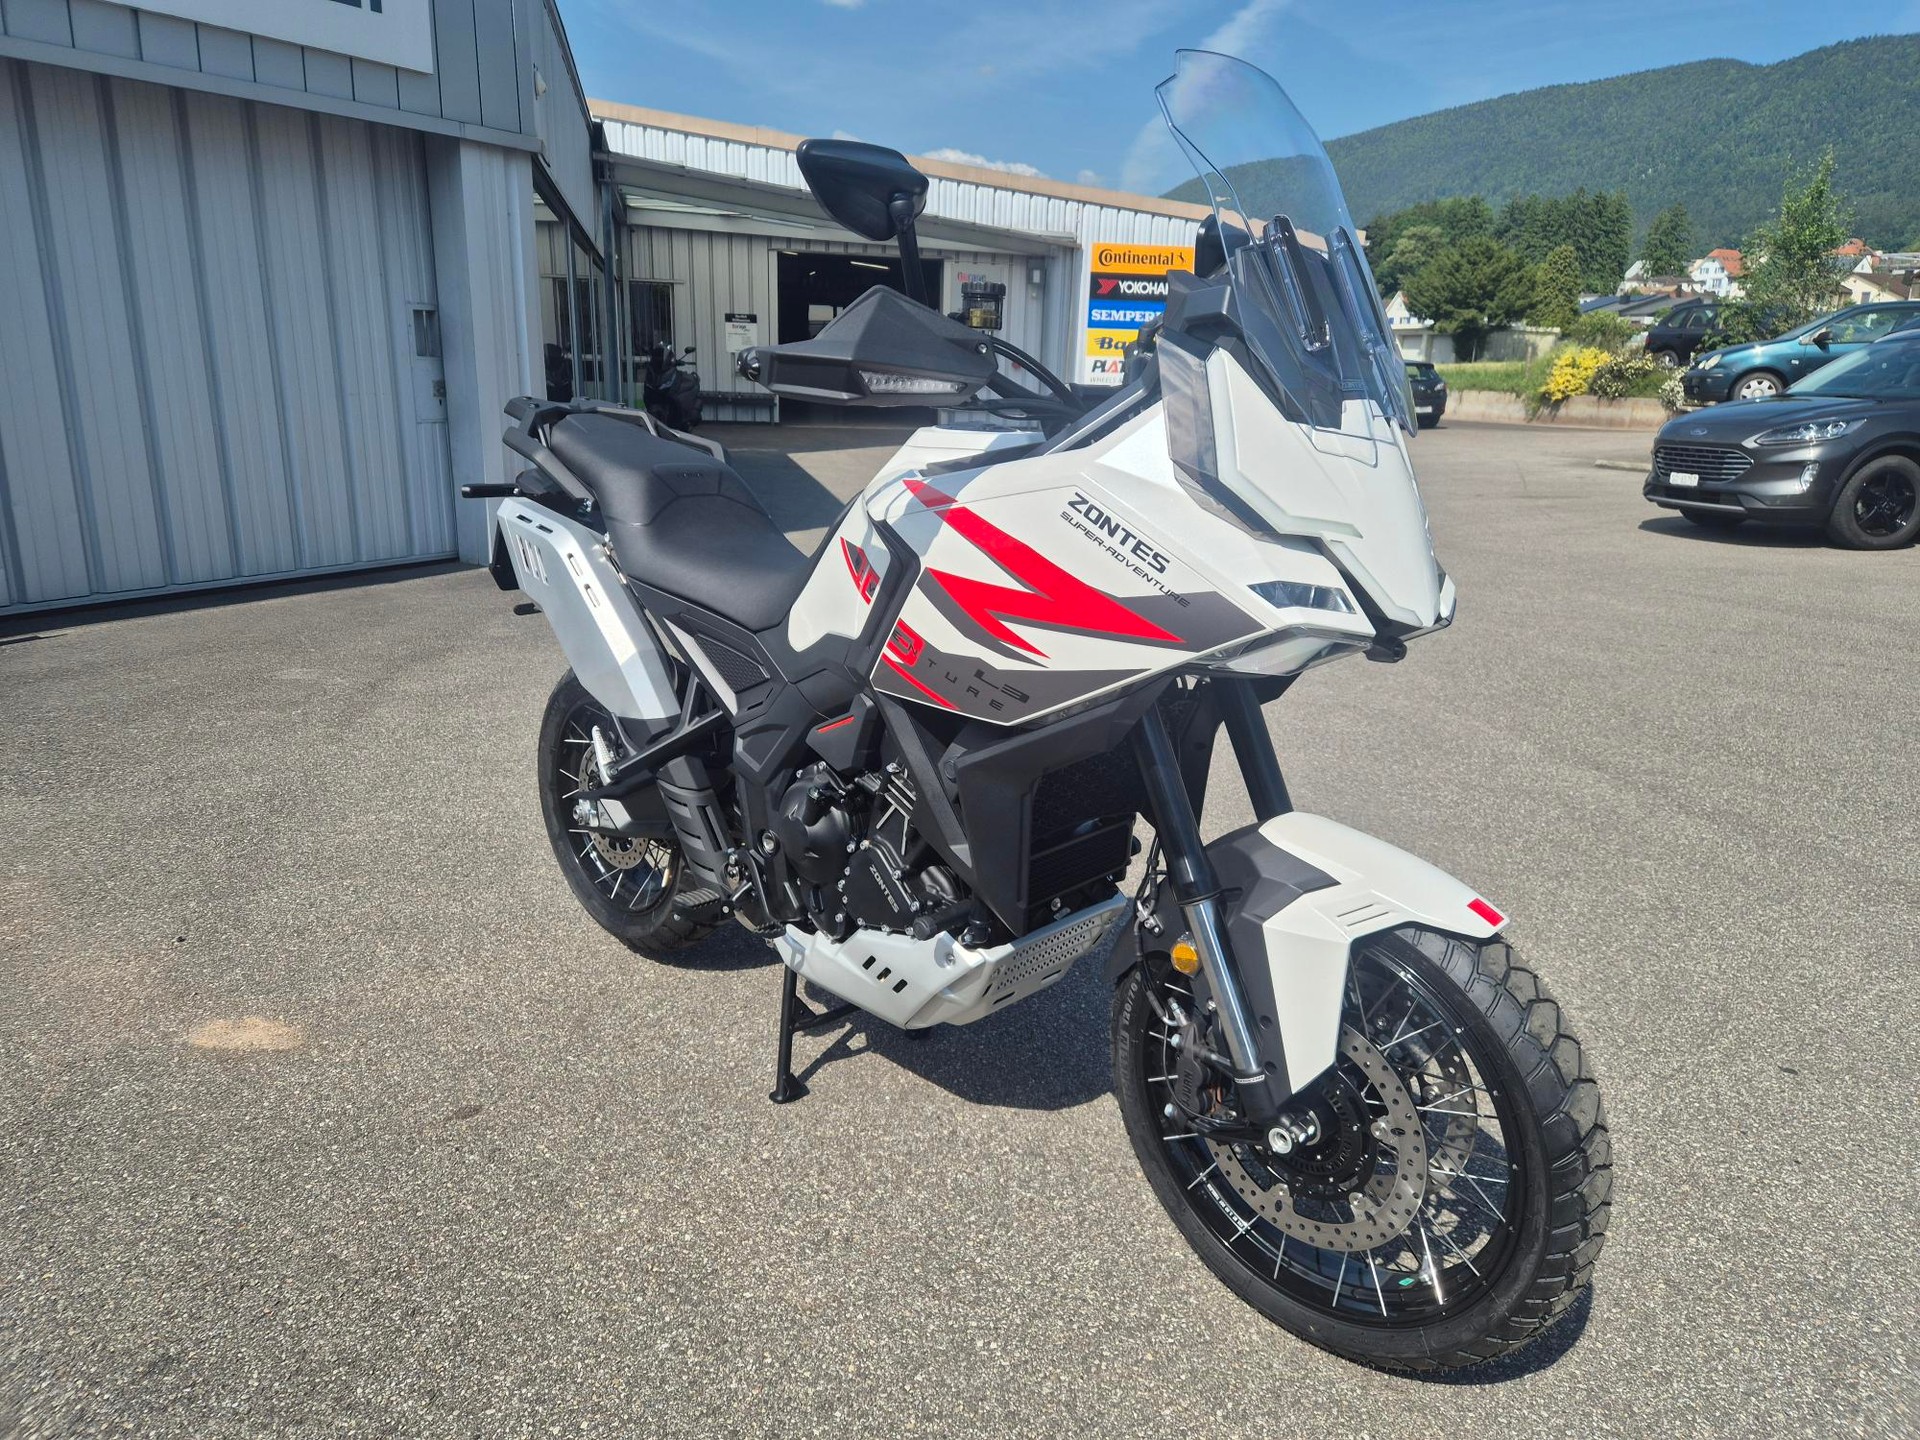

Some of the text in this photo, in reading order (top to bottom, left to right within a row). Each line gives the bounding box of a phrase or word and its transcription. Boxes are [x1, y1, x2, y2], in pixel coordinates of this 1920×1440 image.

[1098, 249, 1174, 266] Continental
[1067, 492, 1170, 574] ZONTES
[1060, 511, 1190, 608] SUPER-ADVENTURE
[869, 864, 900, 913] ZONTES
[1121, 983, 1139, 1027] 120/70
